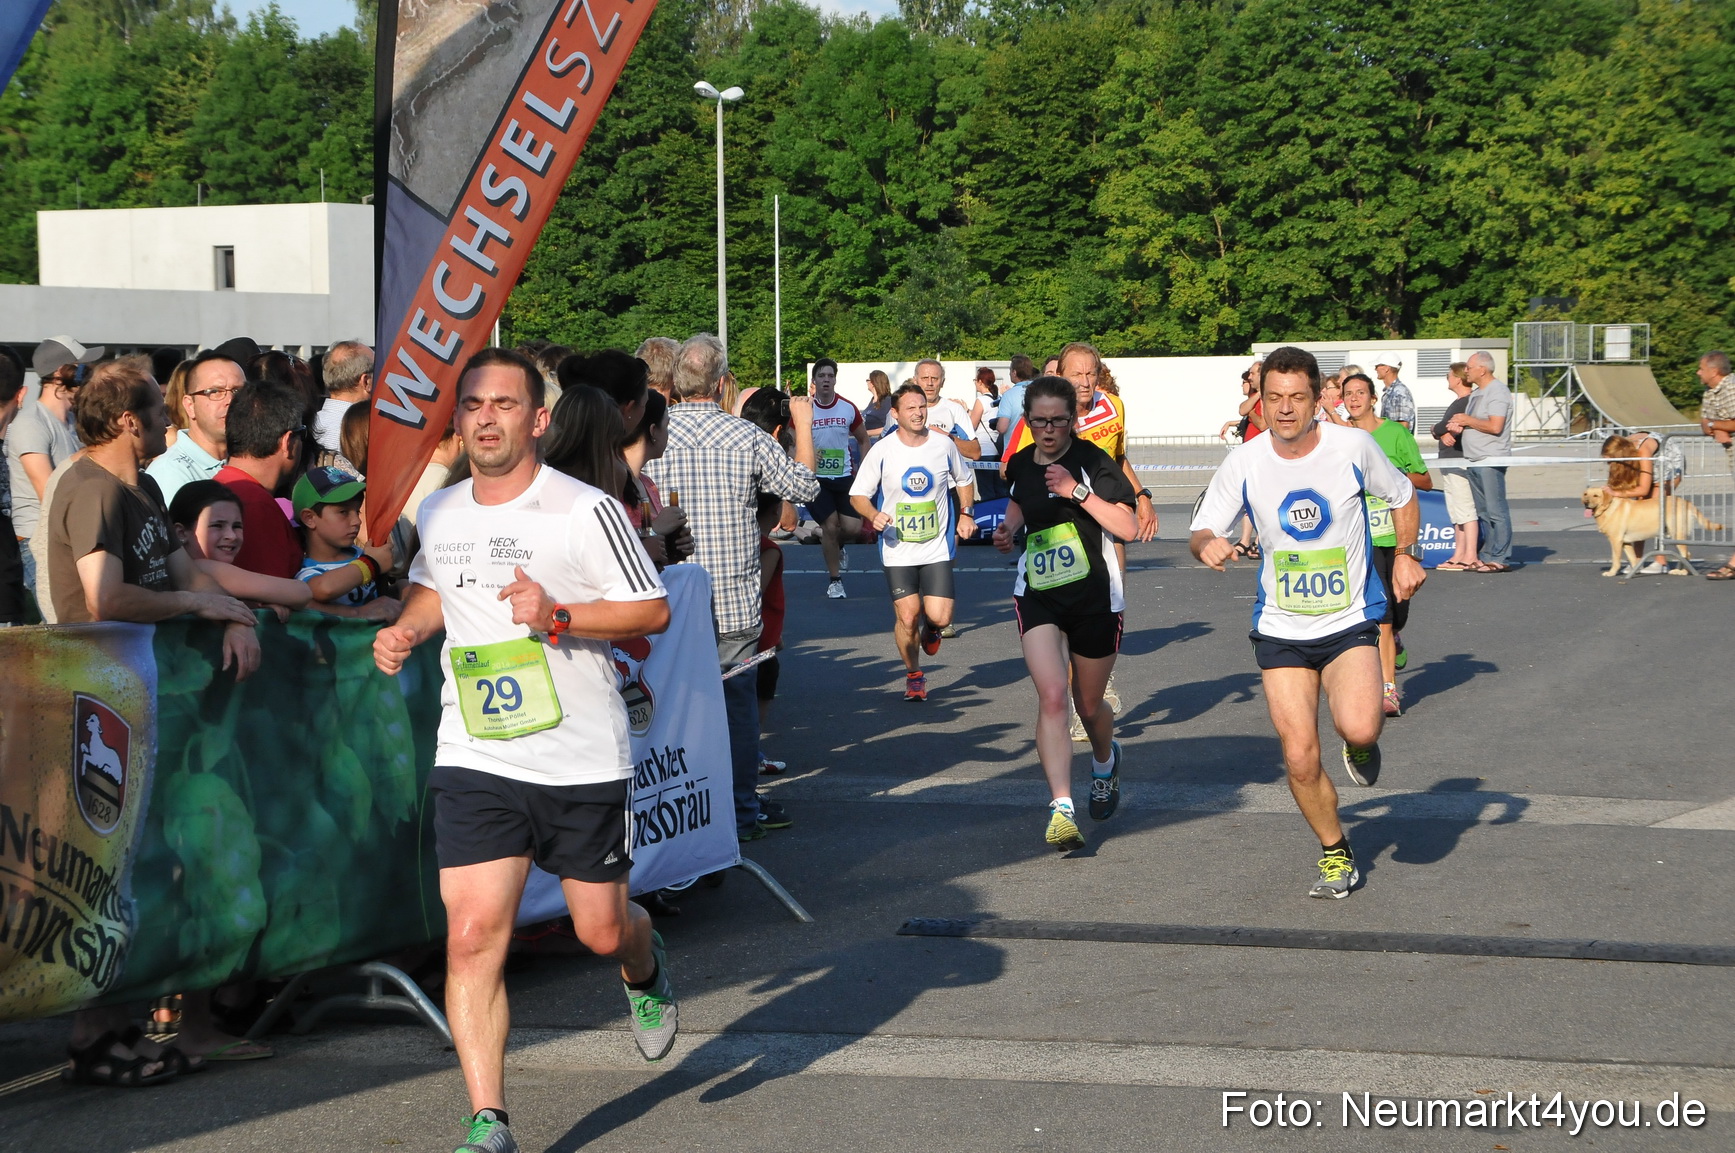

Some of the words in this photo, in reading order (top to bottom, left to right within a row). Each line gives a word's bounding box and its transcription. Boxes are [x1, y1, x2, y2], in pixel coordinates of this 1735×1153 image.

[376, 0, 620, 425] WECHSELSZ
[813, 417, 847, 427] FEIFFER
[1091, 422, 1122, 441] BÖGL
[817, 458, 839, 469] 956
[909, 477, 925, 485] TÜV
[1291, 507, 1317, 520] TÜV
[1370, 509, 1391, 527] 57
[897, 513, 935, 531] 1411
[1300, 521, 1313, 529] SÜD
[433, 542, 475, 553] PEUGEOT
[489, 537, 518, 547] HECK
[490, 547, 533, 559] DESIGN
[435, 554, 471, 565] MÜLLER
[1034, 545, 1075, 576] 979
[1279, 570, 1345, 598] 1406
[476, 676, 523, 715] 29
[488, 715, 509, 723] Thorsten
[520, 718, 537, 726] GmbH
[628, 706, 649, 726] 628
[86, 793, 111, 824] 1628
